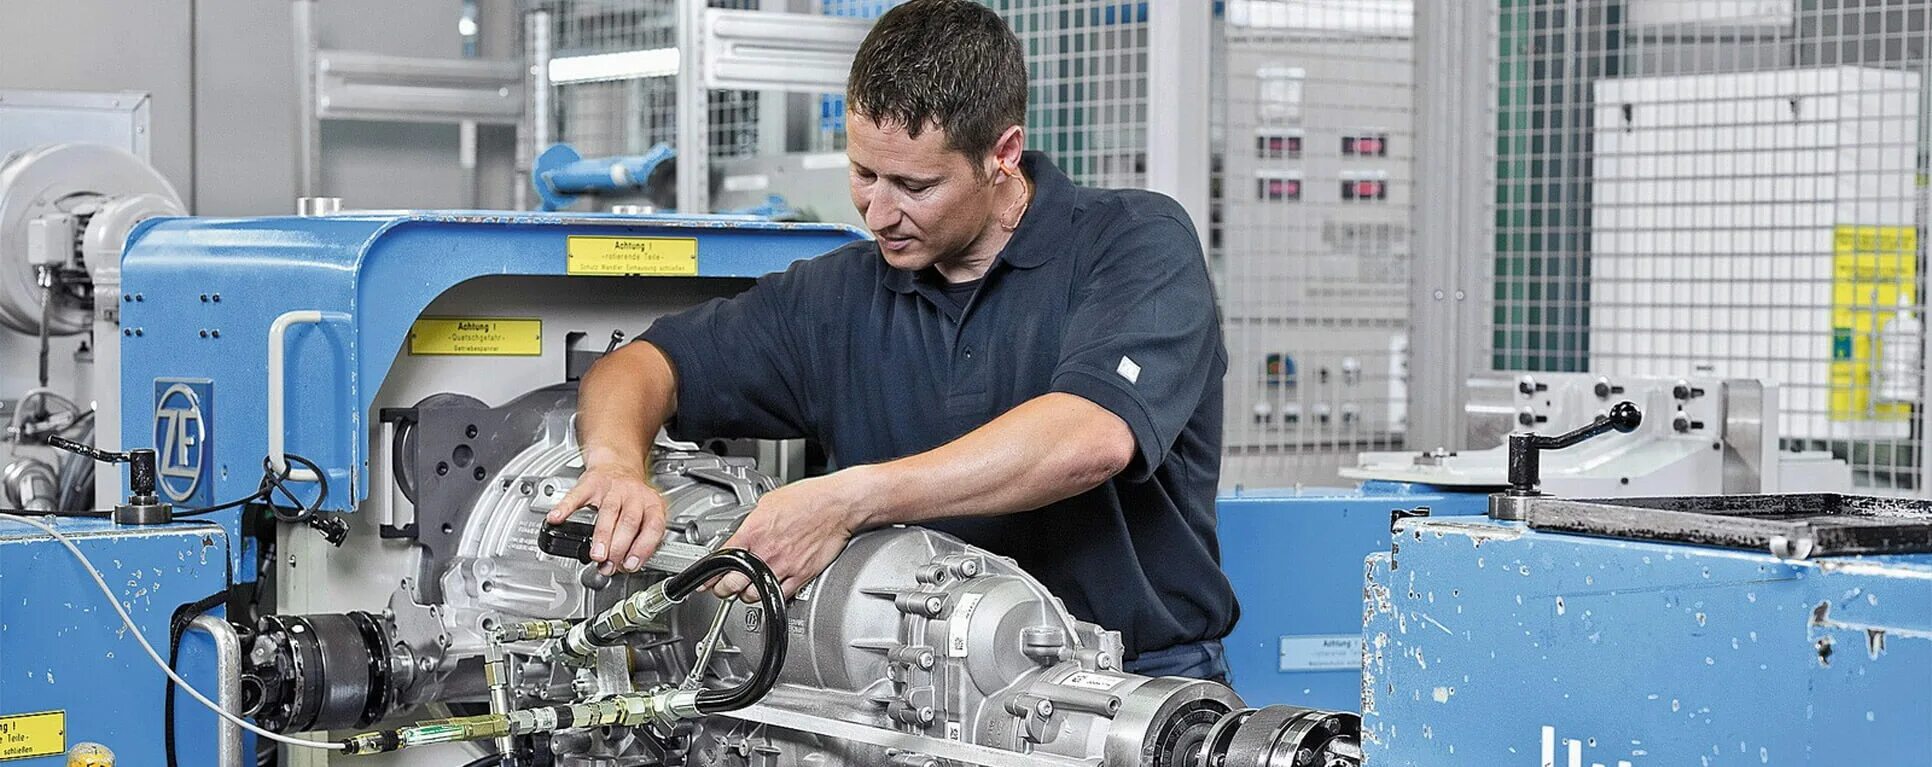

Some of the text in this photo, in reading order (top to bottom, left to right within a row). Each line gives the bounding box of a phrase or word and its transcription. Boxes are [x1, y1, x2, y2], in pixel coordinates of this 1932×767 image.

[614, 241, 645, 252] Achtung
[457, 322, 489, 333] Achtung
[155, 407, 200, 479] ZF
[3, 746, 33, 756] schließen
